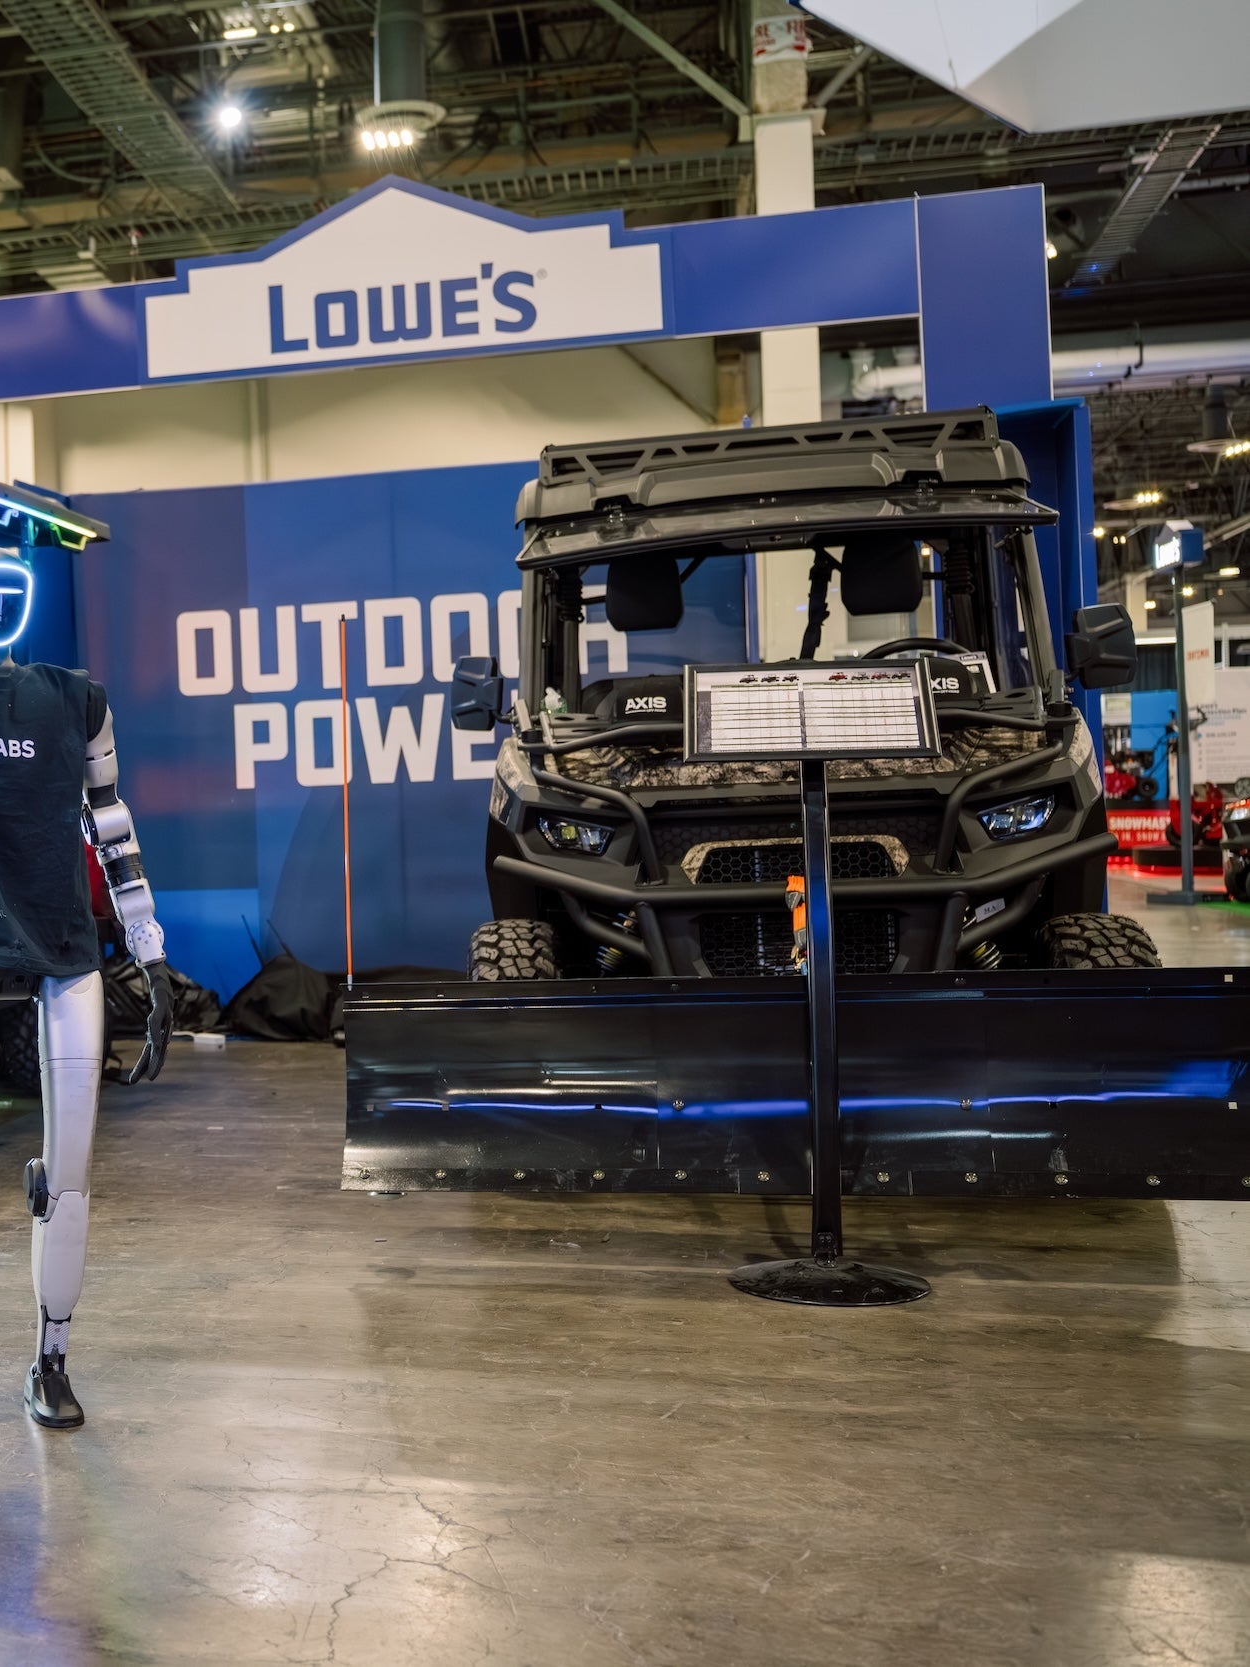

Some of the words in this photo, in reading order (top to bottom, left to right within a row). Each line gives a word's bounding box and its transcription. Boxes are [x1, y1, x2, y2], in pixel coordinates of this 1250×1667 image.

[267, 262, 538, 354] LOWE'S
[930, 677, 960, 690] XIS
[625, 696, 667, 711] AXIS
[233, 689, 519, 790] POWE
[1109, 815, 1171, 831] SNOWMAST
